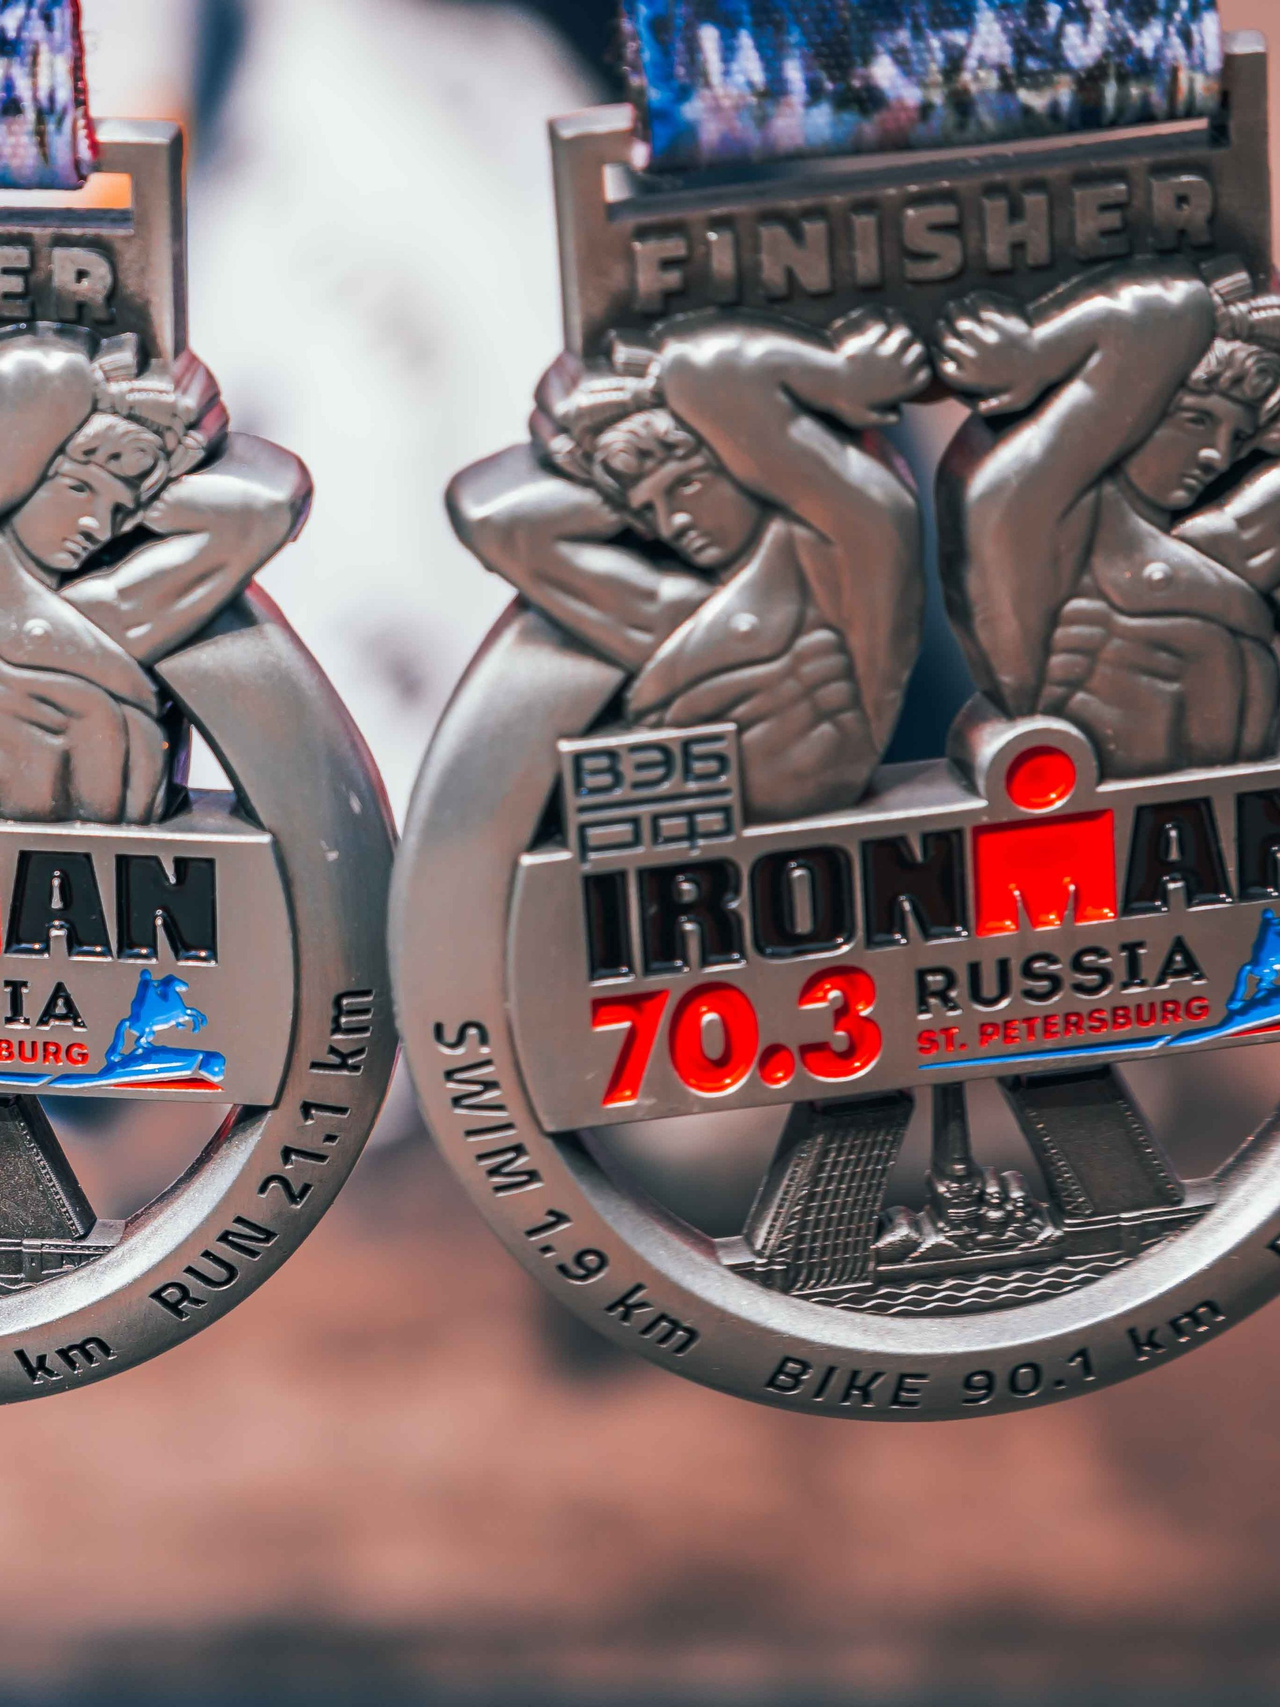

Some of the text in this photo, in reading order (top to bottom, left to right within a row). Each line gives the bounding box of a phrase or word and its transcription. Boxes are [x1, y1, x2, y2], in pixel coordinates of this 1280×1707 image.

[633, 174, 1214, 311] FINISHER
[573, 736, 731, 797] ВЭБ
[915, 935, 1209, 1020] RUSSIA
[917, 997, 1211, 1055] ST. PETERSBURG
[591, 965, 883, 1107] 70.3
[149, 988, 375, 1322] RUN 21.1 km
[433, 1019, 701, 1357] SWIM 1.9 km
[14, 1335, 118, 1386] km
[765, 1299, 1227, 1409] BIKE 90.1 km
